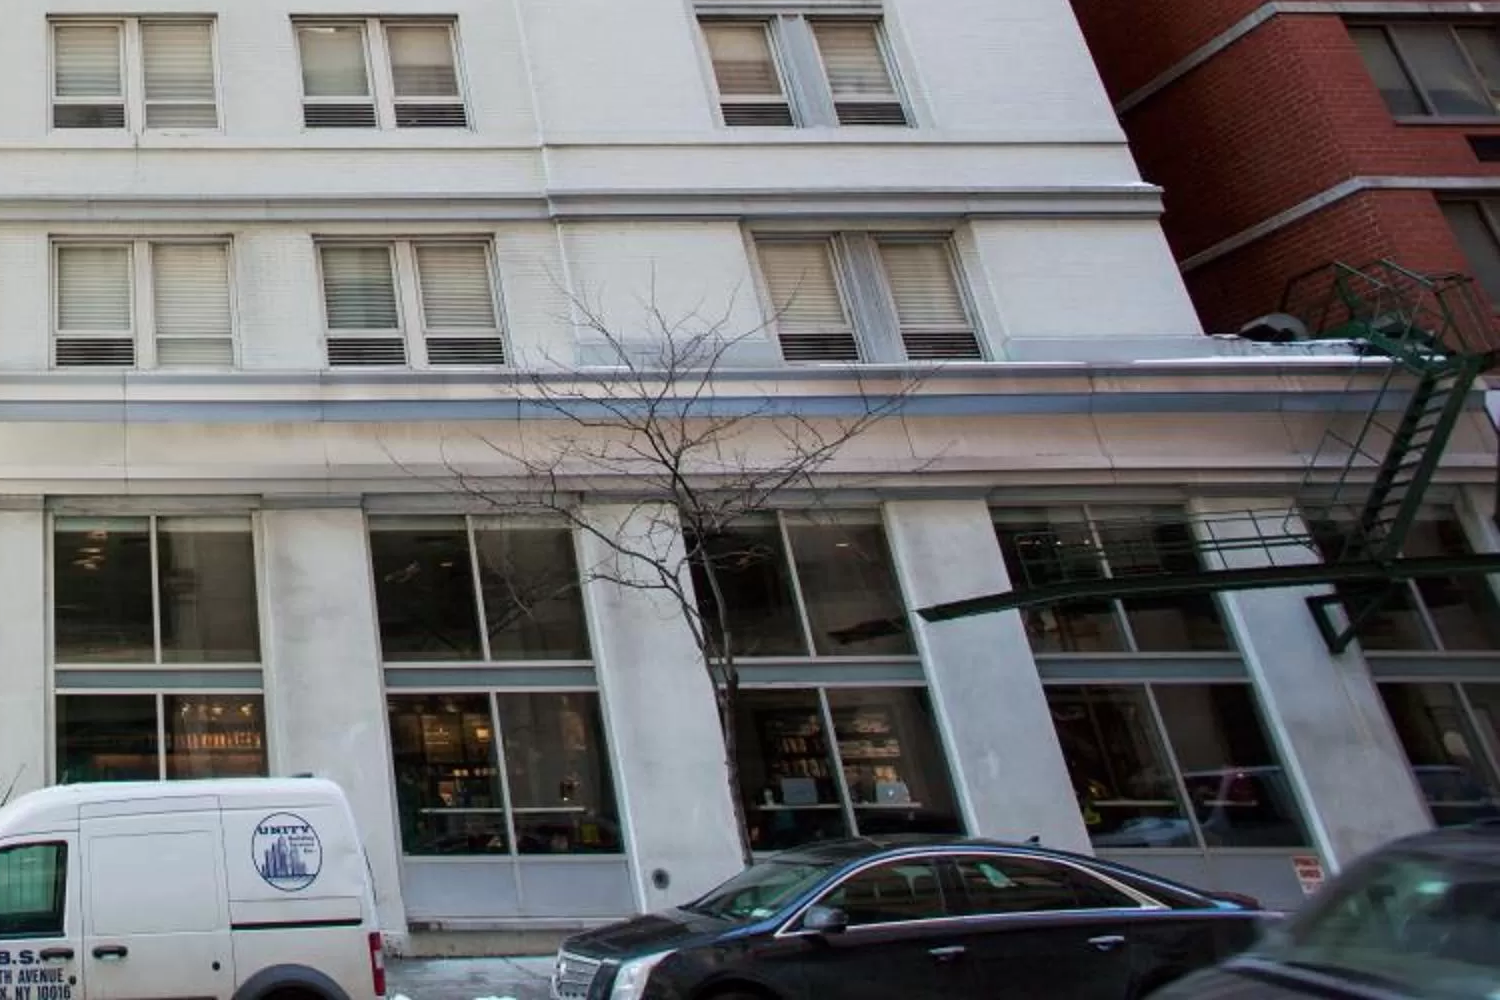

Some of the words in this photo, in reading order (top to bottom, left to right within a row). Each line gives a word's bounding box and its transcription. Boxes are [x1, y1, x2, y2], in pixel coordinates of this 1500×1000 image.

[257, 825, 310, 835] UNITY
[18, 968, 65, 984] AVENUE
[15, 986, 31, 1000] NY
